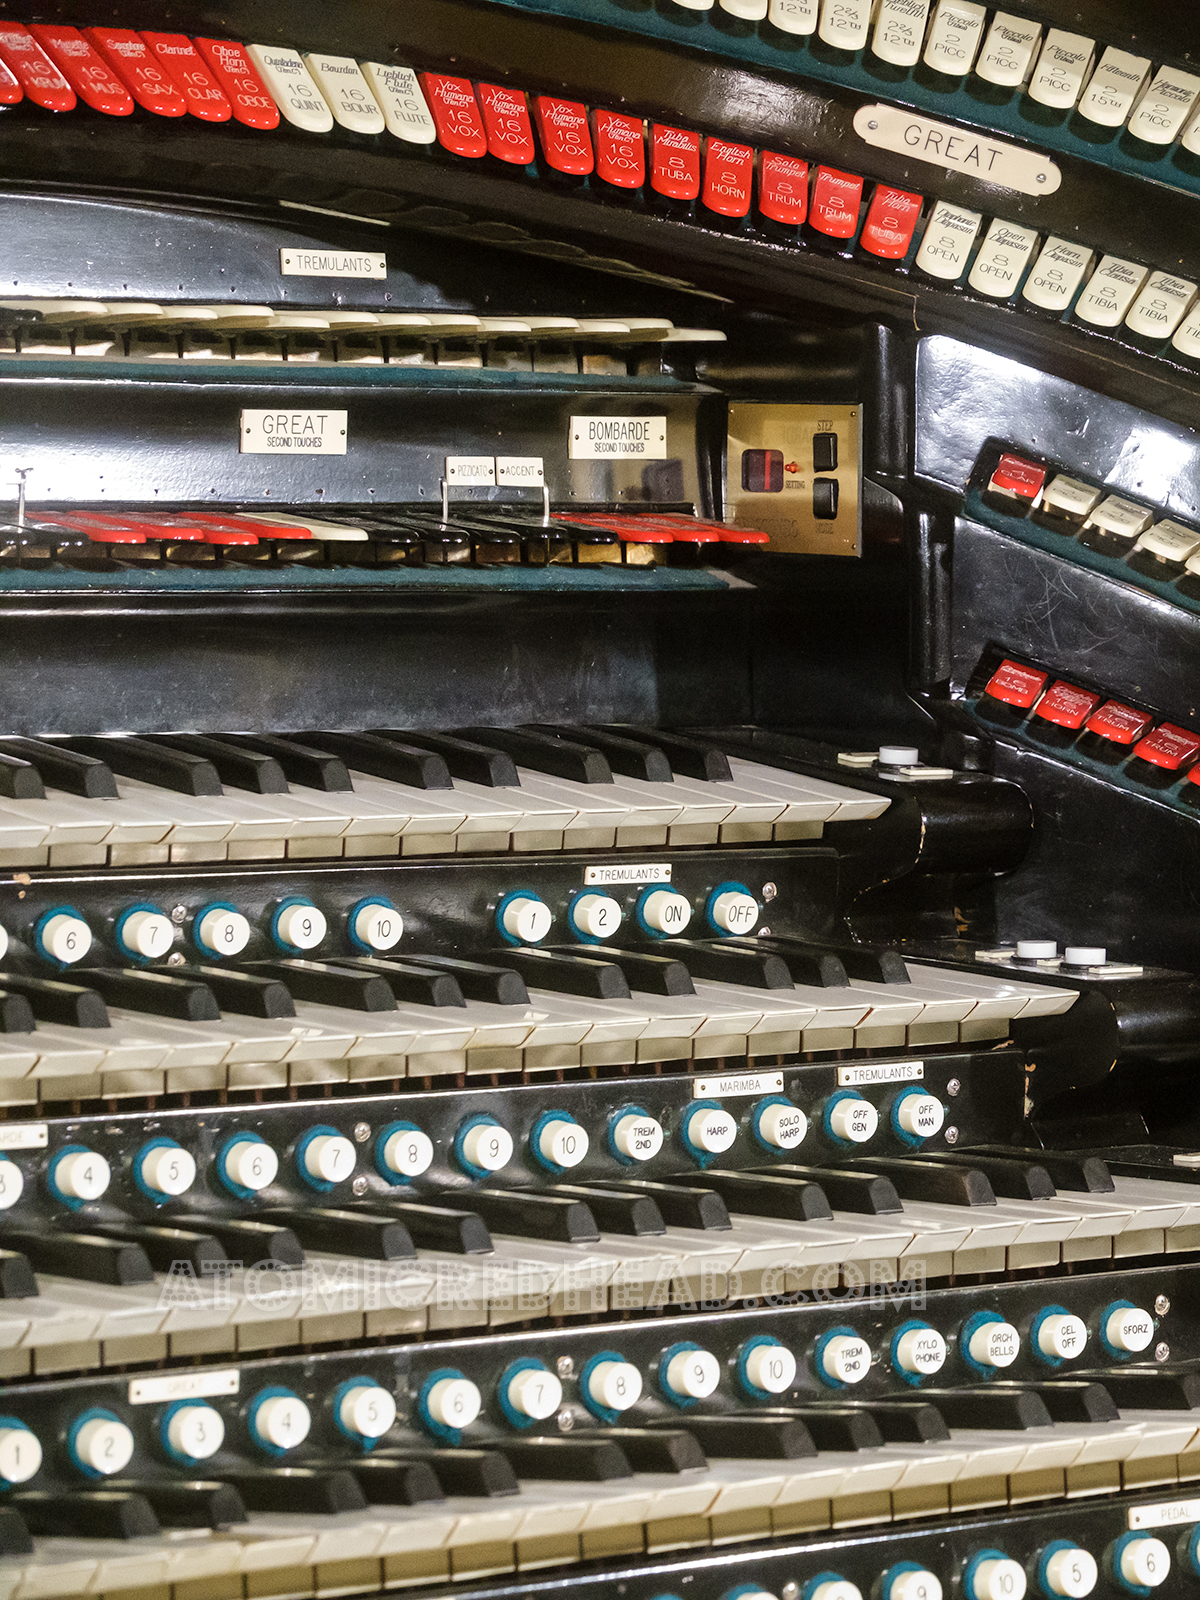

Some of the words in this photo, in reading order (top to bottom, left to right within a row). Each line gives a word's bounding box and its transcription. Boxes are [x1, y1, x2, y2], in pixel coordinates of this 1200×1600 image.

[994, 25, 1034, 42] Piccolo
[212, 45, 240, 57] Oboe
[220, 56, 246, 67] Horn
[986, 54, 1018, 70] PICC
[136, 68, 161, 81] 16
[321, 63, 358, 76] Bourdon
[183, 72, 209, 86] 16
[234, 79, 258, 93] 16
[385, 78, 413, 90] Flute
[438, 79, 462, 91] Vox
[1040, 76, 1071, 92] PICC
[90, 82, 124, 95] MUS
[142, 83, 180, 95] SAX
[188, 88, 225, 100] CLAR
[288, 83, 312, 97] 16
[340, 88, 365, 101] 16
[435, 88, 474, 102] Humana
[238, 95, 273, 109] OBOE
[291, 99, 325, 112] QUINT
[342, 102, 379, 115] BOUR
[396, 98, 419, 111] 16
[395, 111, 430, 125] FLUTE
[449, 110, 472, 124] 16
[447, 123, 482, 139] VOX
[663, 129, 689, 142] Tuba
[611, 144, 634, 157] 16
[656, 136, 697, 152] Mirabilis
[711, 141, 750, 159] English
[904, 124, 1003, 171] GREAT
[606, 155, 639, 171] VOX
[668, 157, 685, 169] 8
[717, 151, 745, 165] Horn
[771, 156, 800, 168] Solo
[659, 167, 694, 182] TUBA
[766, 161, 805, 179] Trumpet
[819, 172, 860, 191] Trumpet
[712, 183, 745, 199] HORN
[768, 192, 802, 208] TRUM
[818, 204, 853, 221] TRUM
[998, 227, 1026, 242] Open
[989, 234, 1029, 252] Diapason
[926, 245, 960, 264] OPEN
[992, 254, 1008, 266] 8
[1052, 245, 1081, 260] Horn
[296, 255, 372, 272] TREMULANTS
[979, 264, 1012, 281] OPEN
[1034, 277, 1067, 295] OPEN
[1088, 294, 1119, 311] TIBIA
[262, 415, 328, 434] GREAT
[588, 422, 650, 440] BOMBARDE
[817, 420, 833, 431] STEP
[266, 437, 292, 447] SECOND
[293, 437, 322, 448] TOUCHES
[594, 442, 617, 452] SECOND
[618, 442, 644, 453] TOUCHES
[458, 465, 488, 477] PIZZICATO
[506, 466, 534, 476] ACCENT
[786, 480, 805, 490] SETTING
[600, 868, 660, 880] TREMULANTS
[530, 912, 536, 930] 1
[598, 908, 607, 926] 2
[665, 906, 682, 922] ON
[728, 906, 754, 922] OFF
[150, 926, 158, 944] 7
[224, 924, 234, 942] 8
[302, 918, 312, 937] 9
[377, 920, 392, 938] 10
[66, 932, 76, 950] 6
[853, 1066, 913, 1081] TREMULANTS
[719, 1079, 761, 1092] MARIMBA
[853, 1110, 868, 1119] OFF
[918, 1105, 934, 1114] OFF
[779, 1115, 800, 1127] SOLO
[852, 1122, 866, 1132] GEN
[918, 1116, 934, 1126] MAN
[634, 1127, 656, 1136] TREM
[706, 1126, 728, 1136] HARP
[780, 1128, 800, 1140] HARP
[490, 1139, 498, 1157] 9
[562, 1136, 576, 1154] 10
[635, 1140, 652, 1150] 2ND
[332, 1150, 340, 1168] 7
[408, 1144, 418, 1162] 8
[169, 1161, 178, 1180] 5
[252, 1157, 262, 1176] 6
[84, 1166, 92, 1184] 4
[1061, 1325, 1076, 1335] CEL
[1124, 1324, 1148, 1334] SFORZ
[916, 1340, 938, 1350] XYLO
[992, 1333, 1012, 1343] ORCH
[1062, 1338, 1076, 1348] OFF
[842, 1347, 863, 1358] TREM
[915, 1352, 942, 1362] PHONE
[990, 1346, 1014, 1356] BELLS
[694, 1365, 704, 1383] 9
[768, 1360, 784, 1379] 10
[844, 1361, 860, 1372] 2ND
[616, 1376, 626, 1395] 8
[536, 1384, 544, 1404] 7
[454, 1394, 463, 1412] 6
[368, 1402, 378, 1421] 5
[282, 1412, 291, 1431] 4
[196, 1422, 206, 1442] 3
[104, 1437, 114, 1458] 2
[15, 1446, 20, 1465] 1
[1161, 1507, 1191, 1520] PEDAL
[1146, 1554, 1156, 1572] 6
[1072, 1564, 1082, 1582] 5
[999, 1574, 1013, 1593] 10
